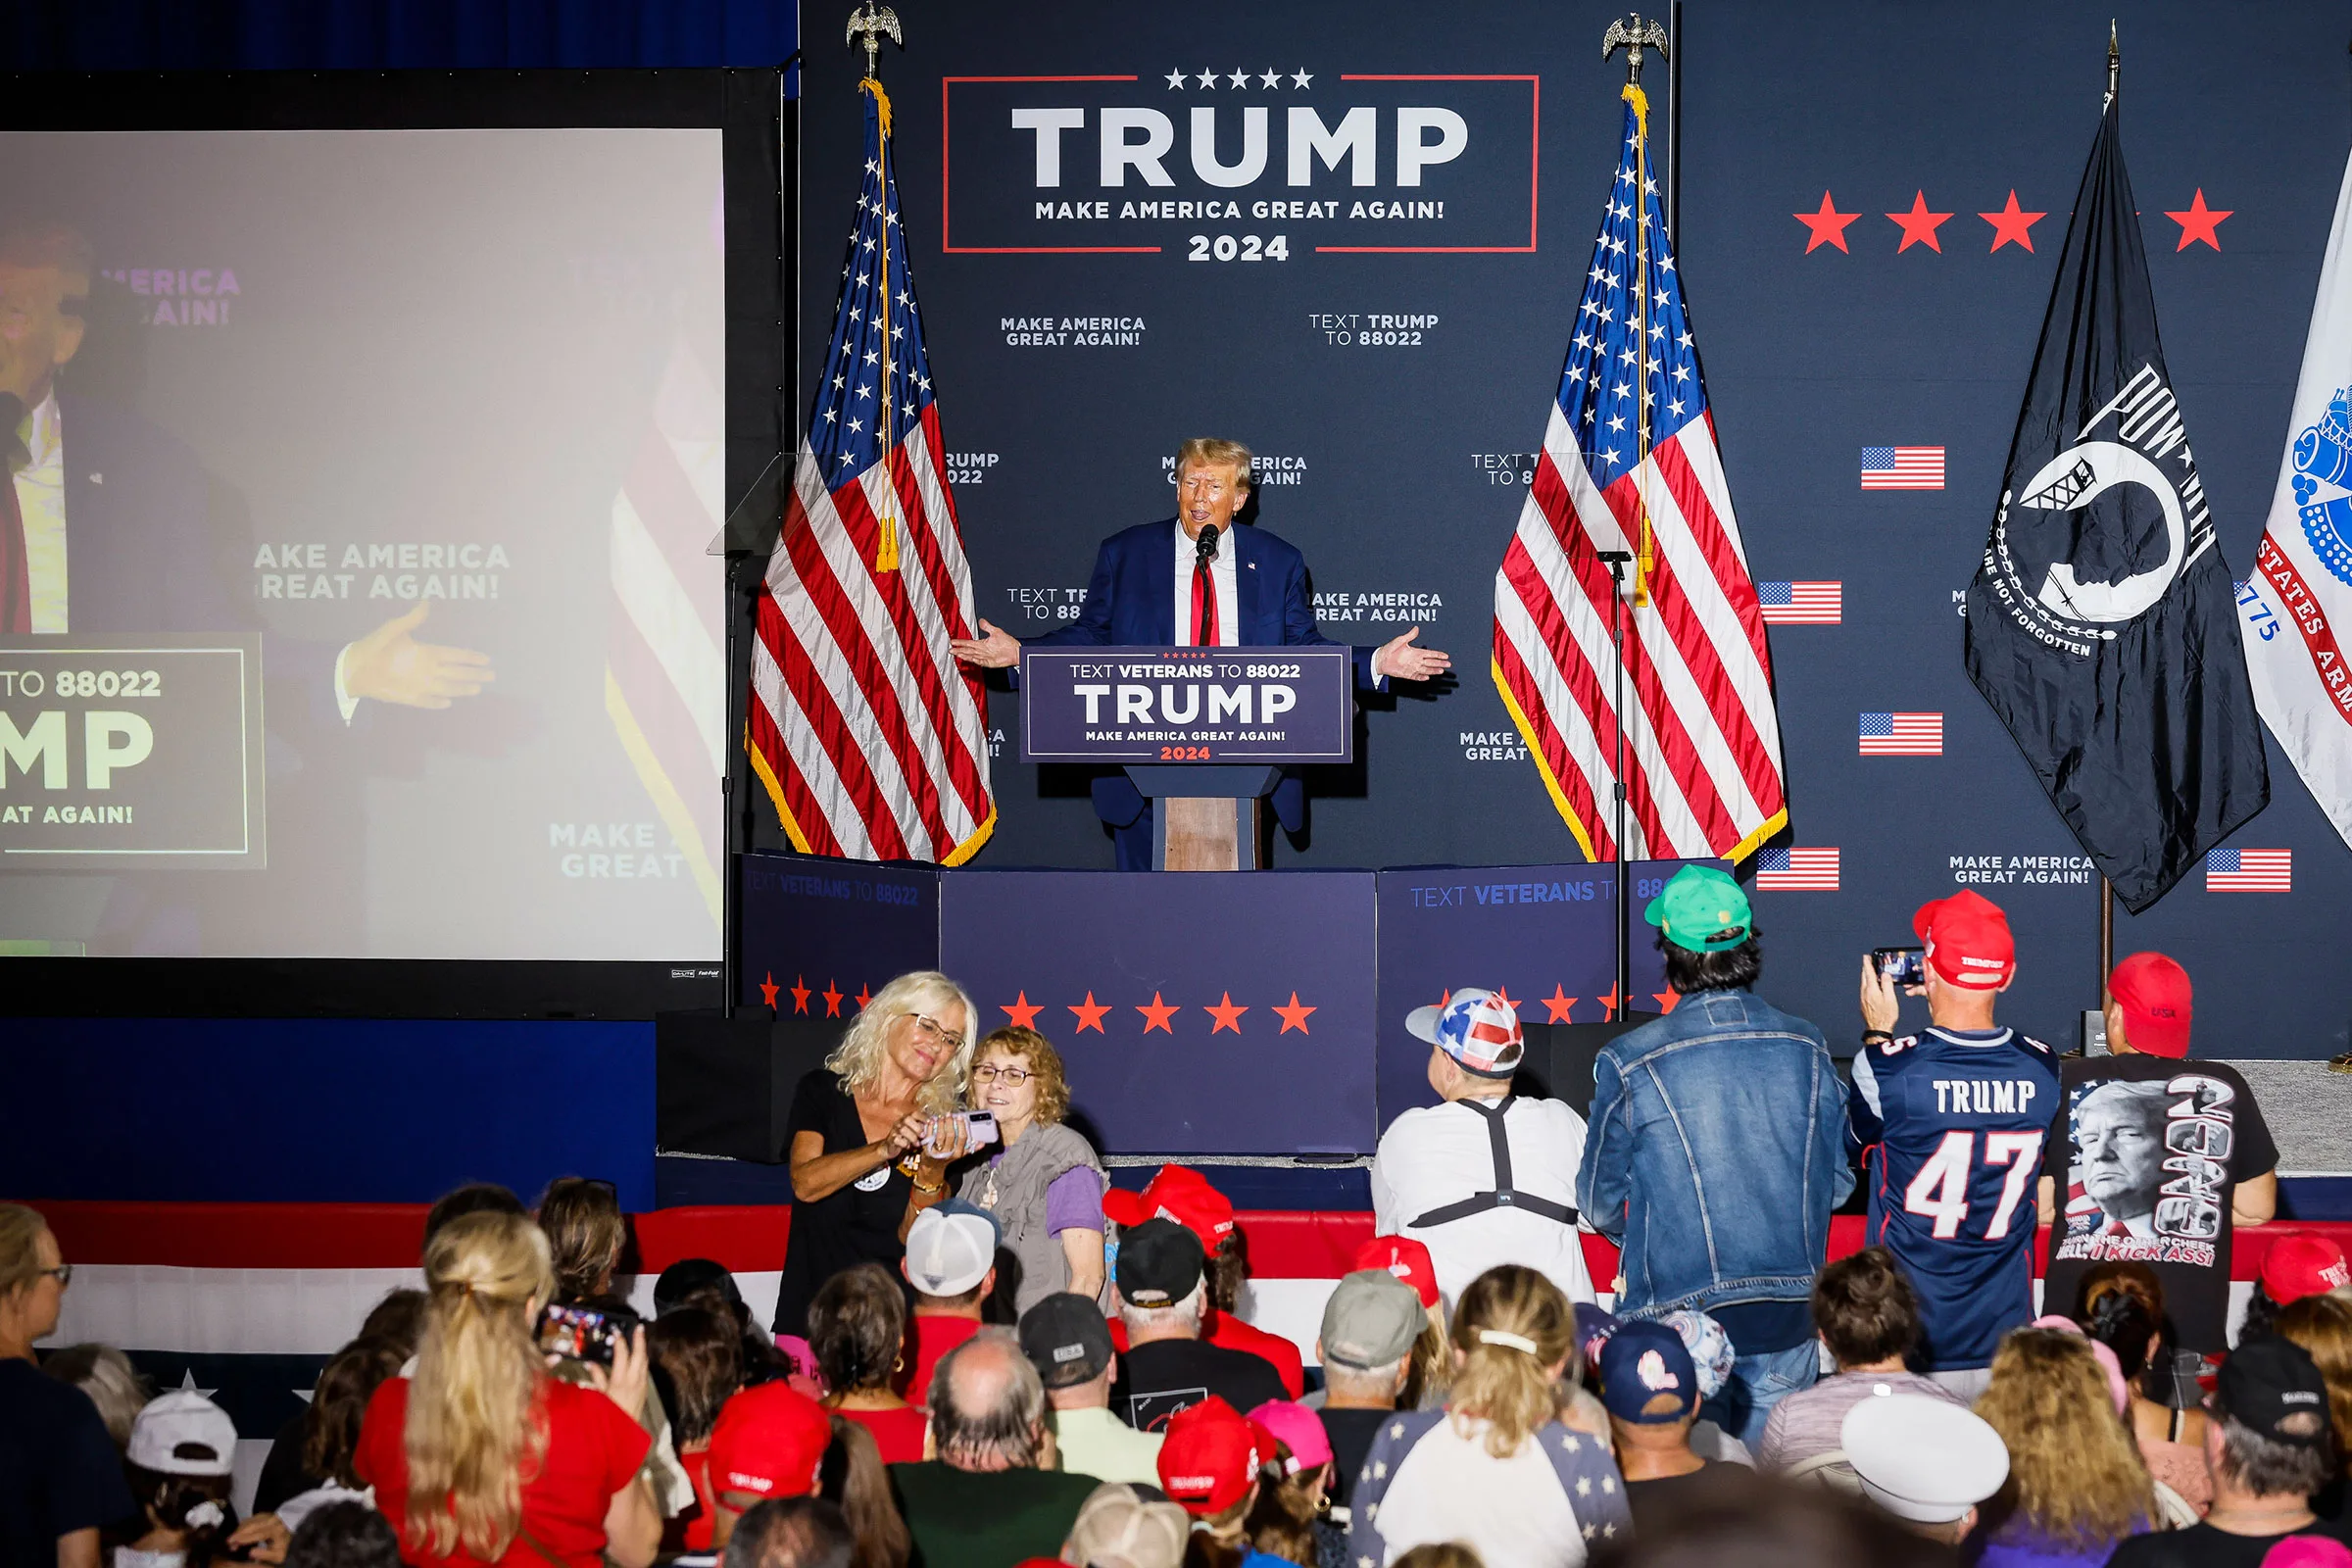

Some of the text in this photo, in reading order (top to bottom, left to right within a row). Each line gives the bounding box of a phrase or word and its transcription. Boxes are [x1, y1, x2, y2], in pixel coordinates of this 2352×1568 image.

[1011, 107, 1469, 188] TRUMP
[1035, 200, 1446, 220] MAKE AMERICA GREAT AGAIN!
[1188, 234, 1290, 262] 2024
[102, 268, 241, 296] ERICA
[153, 299, 229, 326] AIN!
[1308, 314, 1439, 329] TEXT TRUMP
[1001, 317, 1146, 331] MAKE AMERICA
[1005, 332, 1140, 346] GREAT AGAIN!
[1325, 330, 1422, 346] TO 88022
[2073, 362, 2186, 460] POW
[946, 453, 1000, 467] RUMP
[1250, 457, 1307, 470] ERICA
[1471, 454, 1523, 468] TEXT
[947, 469, 983, 484] 022
[1250, 471, 1301, 485] GAIN!
[1487, 470, 1514, 485] TO
[254, 543, 511, 568] AKE AMERICA
[261, 574, 499, 600] REAT AGAIN!
[1006, 588, 1057, 603] TEXT
[2257, 539, 2325, 636] STATES
[1311, 593, 1443, 607] AKE AMERICA
[1023, 605, 1050, 619] TO
[1315, 608, 1437, 621] REAT AGAIN!
[1992, 577, 2015, 606] NOT
[2011, 607, 2091, 658] FORGOTTEN
[2237, 584, 2281, 642] 775
[1070, 664, 1300, 678] TEXT VETERANS TO 88022
[0, 670, 161, 698] TO 88022
[2317, 650, 2352, 713] ARM
[1073, 684, 1297, 725] TRUMP
[1085, 731, 1286, 742] MAKE AMERICA GREAT AGAIN!
[1459, 732, 1513, 745] MAKE
[0, 710, 154, 790] MP
[1160, 746, 1211, 760] 2024
[1465, 747, 1527, 760] GREAT
[43, 806, 133, 824] AGAIN!
[549, 823, 656, 848] MAKE
[561, 854, 684, 879] GREAT
[1949, 856, 2095, 869] MAKE AMERICA
[1954, 870, 2089, 884] GREAT AGAIN!
[780, 875, 851, 900] VETERANS
[857, 881, 872, 901] TO
[876, 884, 919, 906] 88022
[1410, 886, 1466, 907] TEXT
[1474, 881, 1594, 906] VETERANS
[1600, 879, 1616, 901] T
[1933, 1080, 2036, 1113] TRUMP
[1903, 1129, 2044, 1241] 47
